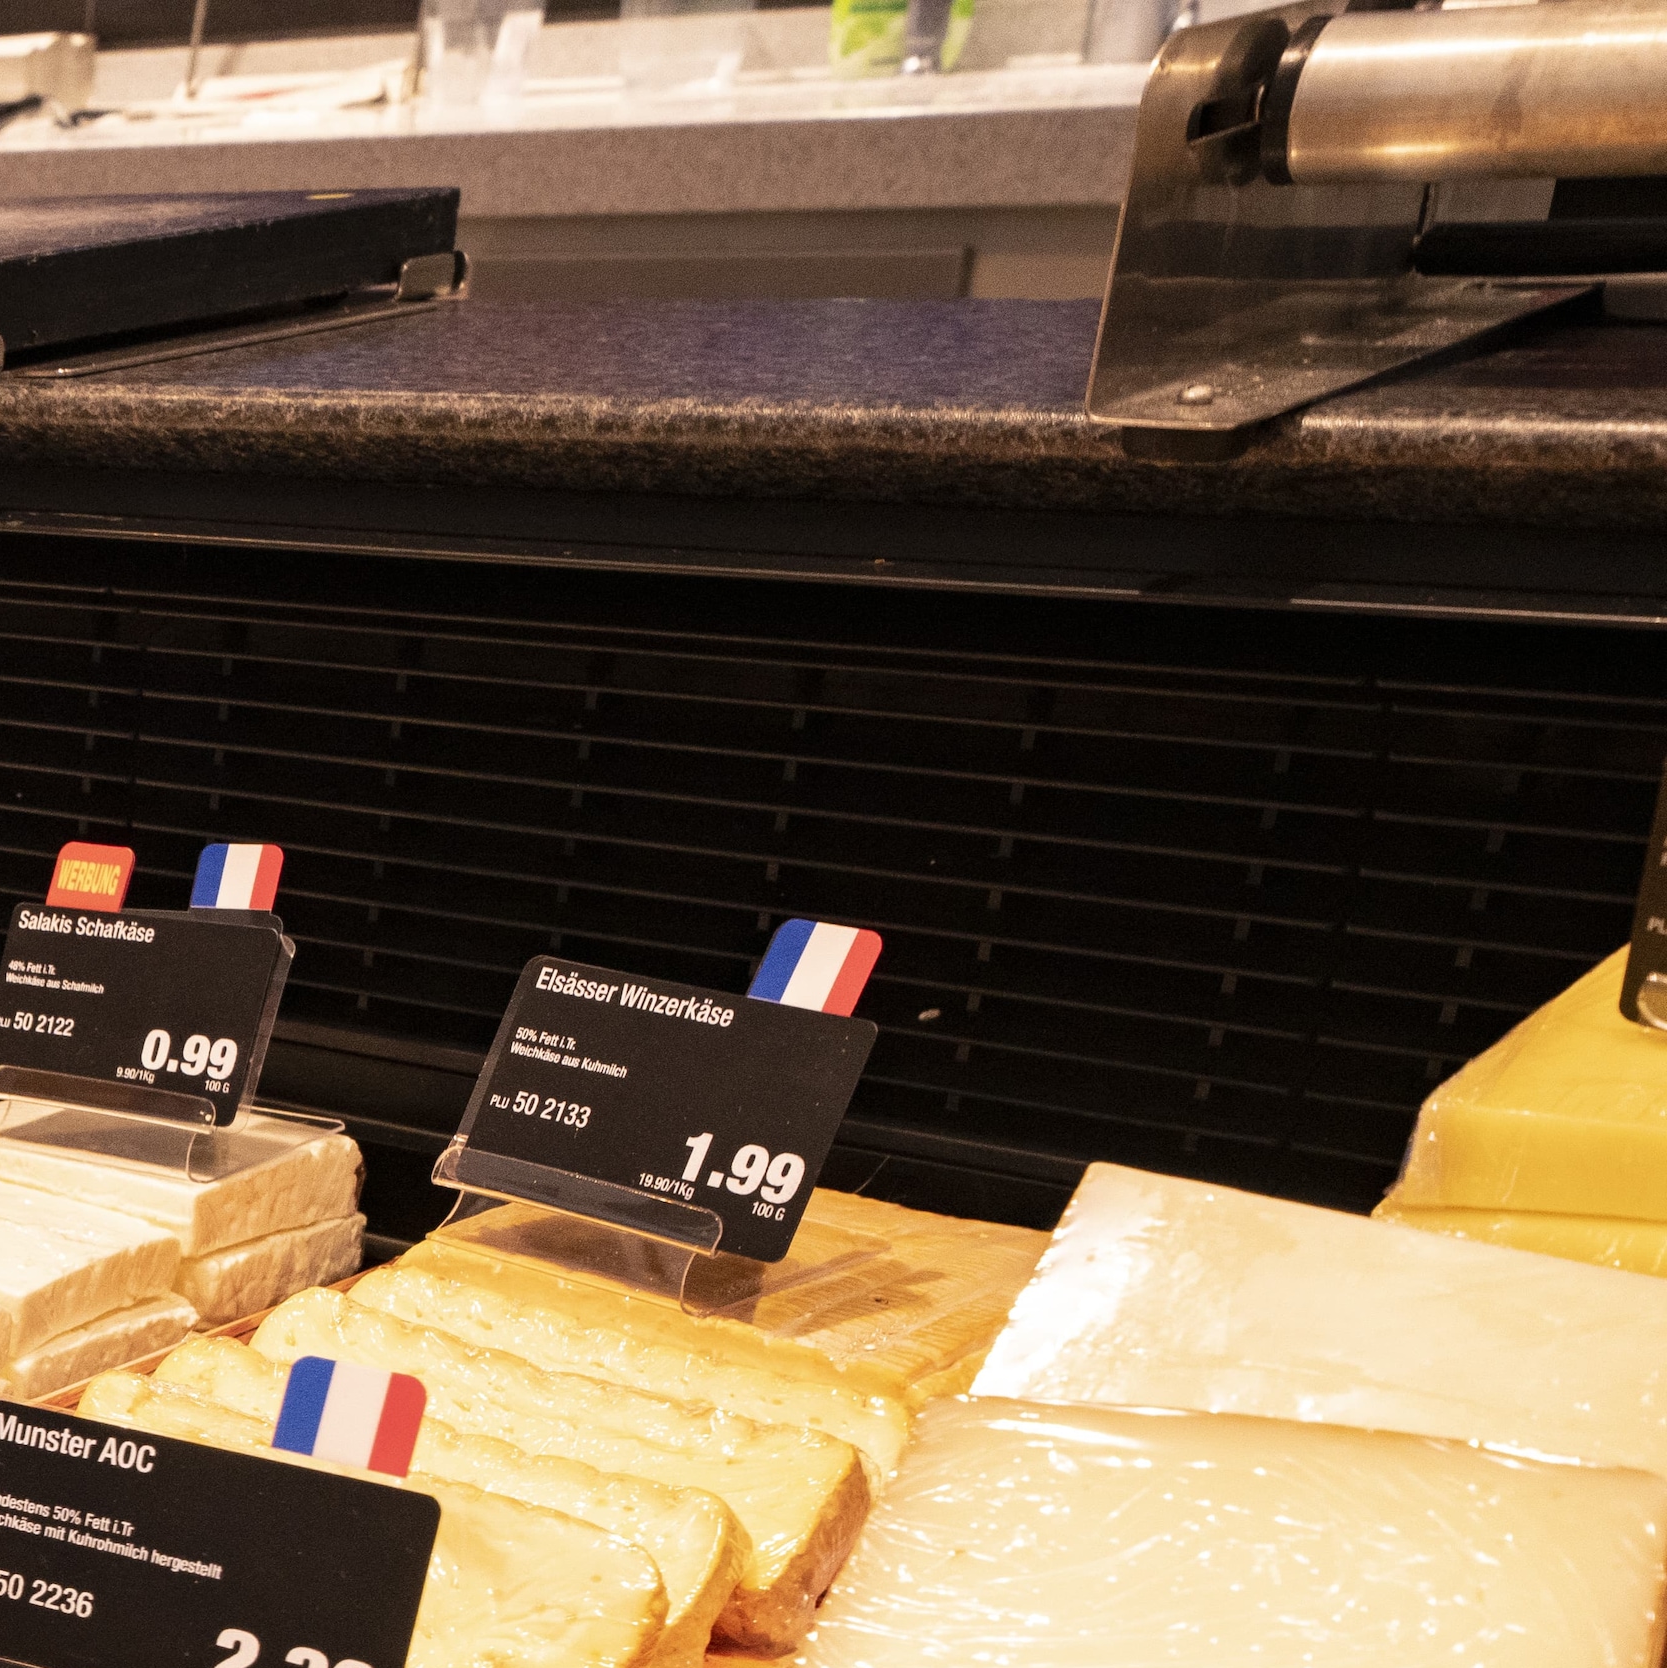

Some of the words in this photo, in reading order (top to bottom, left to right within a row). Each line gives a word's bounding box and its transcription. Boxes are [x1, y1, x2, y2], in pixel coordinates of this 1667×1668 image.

[58, 860, 121, 895] WERBUNG
[18, 910, 72, 934] Salakis
[76, 916, 155, 943] Schafkäse
[6, 973, 45, 987] Weichkäse
[47, 979, 60, 989] aus
[62, 979, 104, 994] Schafmilch
[26, 962, 42, 974] Fett
[536, 967, 618, 1002] Elsässer
[619, 983, 734, 1028] Winzerkäse
[13, 1012, 33, 1031] 50
[35, 1015, 74, 1037] 2122
[516, 1027, 537, 1043] 50%
[538, 1031, 560, 1048] Fett
[140, 1029, 238, 1080] 0.99
[510, 1041, 560, 1065] Weichkäse
[561, 1052, 580, 1068] aus
[581, 1057, 627, 1079] Kuhmilch
[116, 1066, 155, 1084] 9.90/1Kg
[204, 1079, 221, 1092] 100
[221, 1082, 230, 1093] G
[490, 1094, 510, 1109] PLU
[512, 1091, 539, 1116] 50
[540, 1097, 591, 1129] 2133
[681, 1132, 806, 1204] 1.99
[638, 1172, 695, 1200] 19.90/1Kg
[752, 1201, 774, 1218] 100
[774, 1207, 786, 1222] G
[98, 1437, 157, 1474] AOC
[53, 1505, 82, 1525] 50%
[85, 1513, 110, 1531] Fett
[44, 1522, 65, 1541] mit
[67, 1528, 149, 1562] Kuhrohmilch
[151, 1549, 223, 1580] hergestellt
[29, 1579, 94, 1618] 2236
